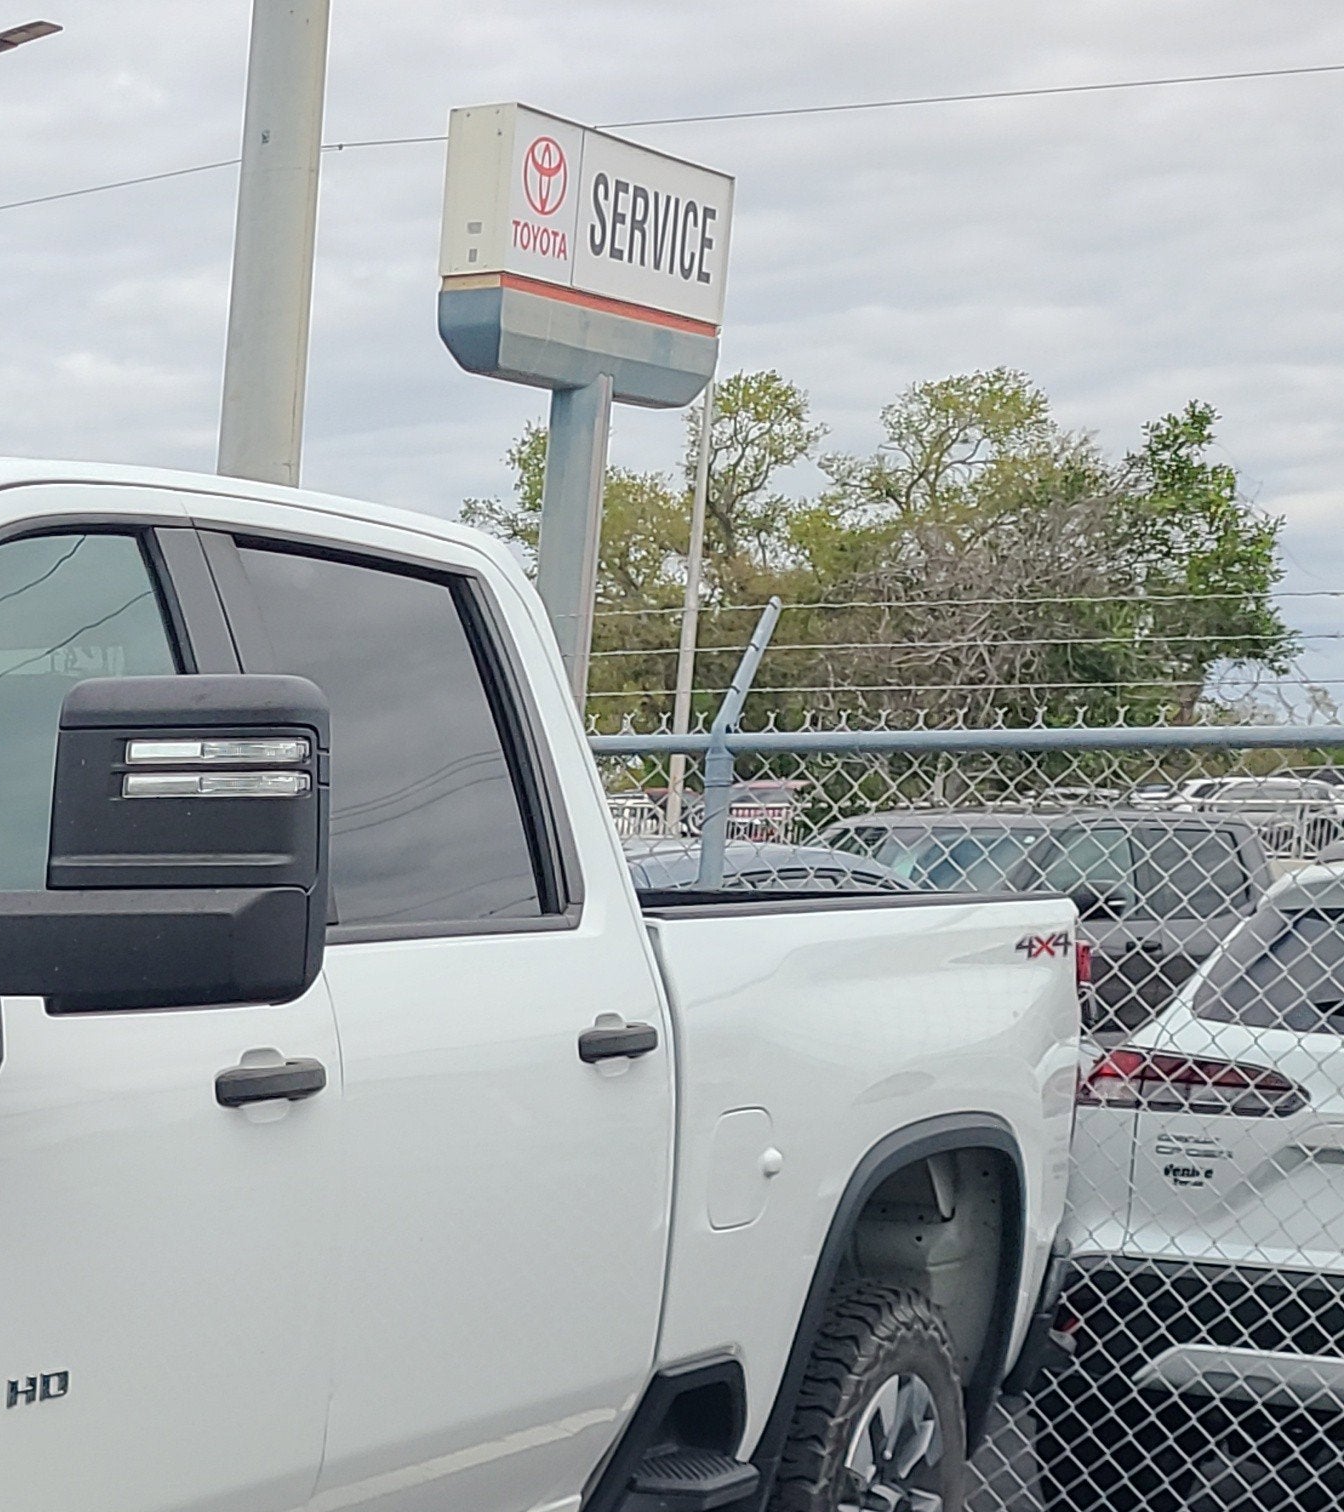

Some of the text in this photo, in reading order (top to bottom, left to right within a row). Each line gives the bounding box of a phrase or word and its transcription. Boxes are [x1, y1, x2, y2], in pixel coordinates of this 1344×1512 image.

[512, 219, 568, 261] TOYOTA
[589, 172, 717, 285] SERVICE
[6, 1369, 71, 1409] HD
